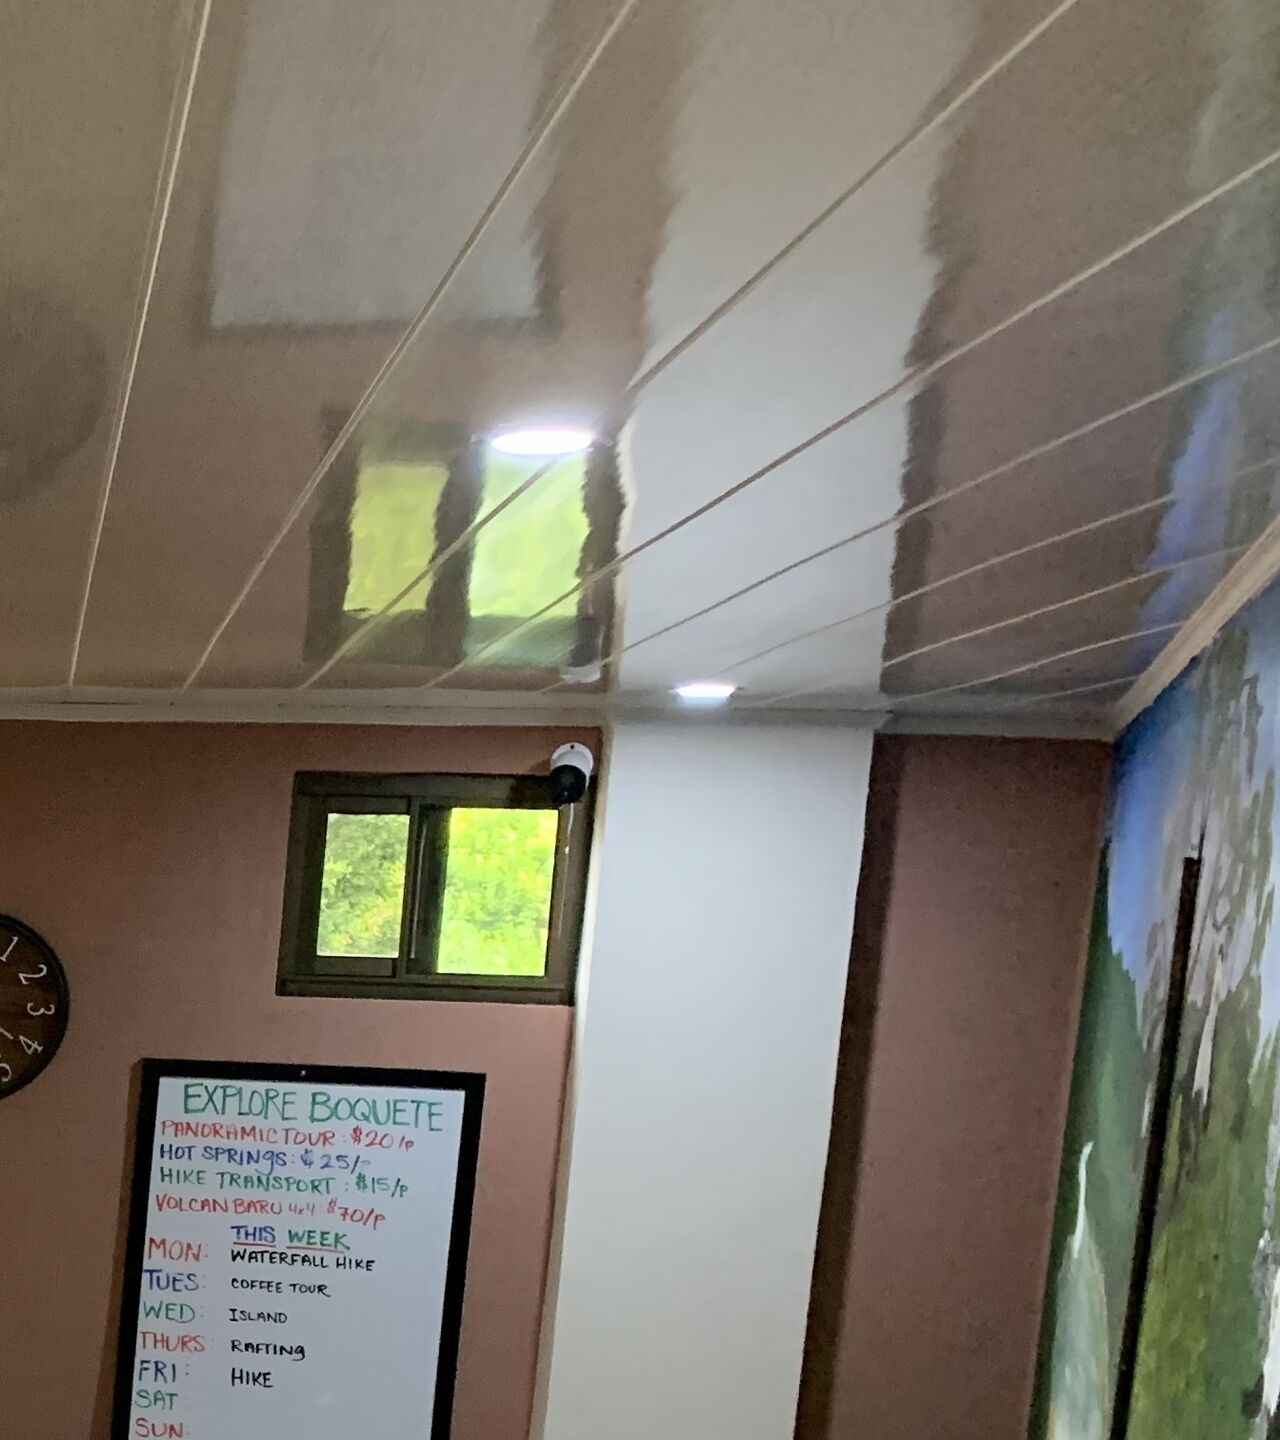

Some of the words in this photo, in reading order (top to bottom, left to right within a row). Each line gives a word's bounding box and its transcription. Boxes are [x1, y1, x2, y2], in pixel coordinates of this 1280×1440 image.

[0, 936, 19, 962] 1
[18, 964, 47, 985] 2
[26, 1002, 55, 1017] 3
[18, 1034, 44, 1056] 4
[183, 1083, 297, 1121] EXPLORE
[308, 1091, 444, 1132] BOQUETE
[161, 1119, 278, 1144] PANORAMIC
[160, 1143, 196, 1160] HOT
[160, 1166, 206, 1185] HIKE
[155, 1193, 228, 1213] VOLCAN
[232, 1198, 282, 1215] BARU
[230, 1225, 277, 1244] THIS
[287, 1228, 351, 1251] WEEK
[230, 1249, 329, 1268] WATERFALL
[336, 1256, 376, 1272] HIKE
[231, 1277, 283, 1294] COFFEE
[289, 1282, 332, 1297] TOUR
[229, 1308, 288, 1324] ISLAND
[231, 1368, 274, 1388] HIKE
